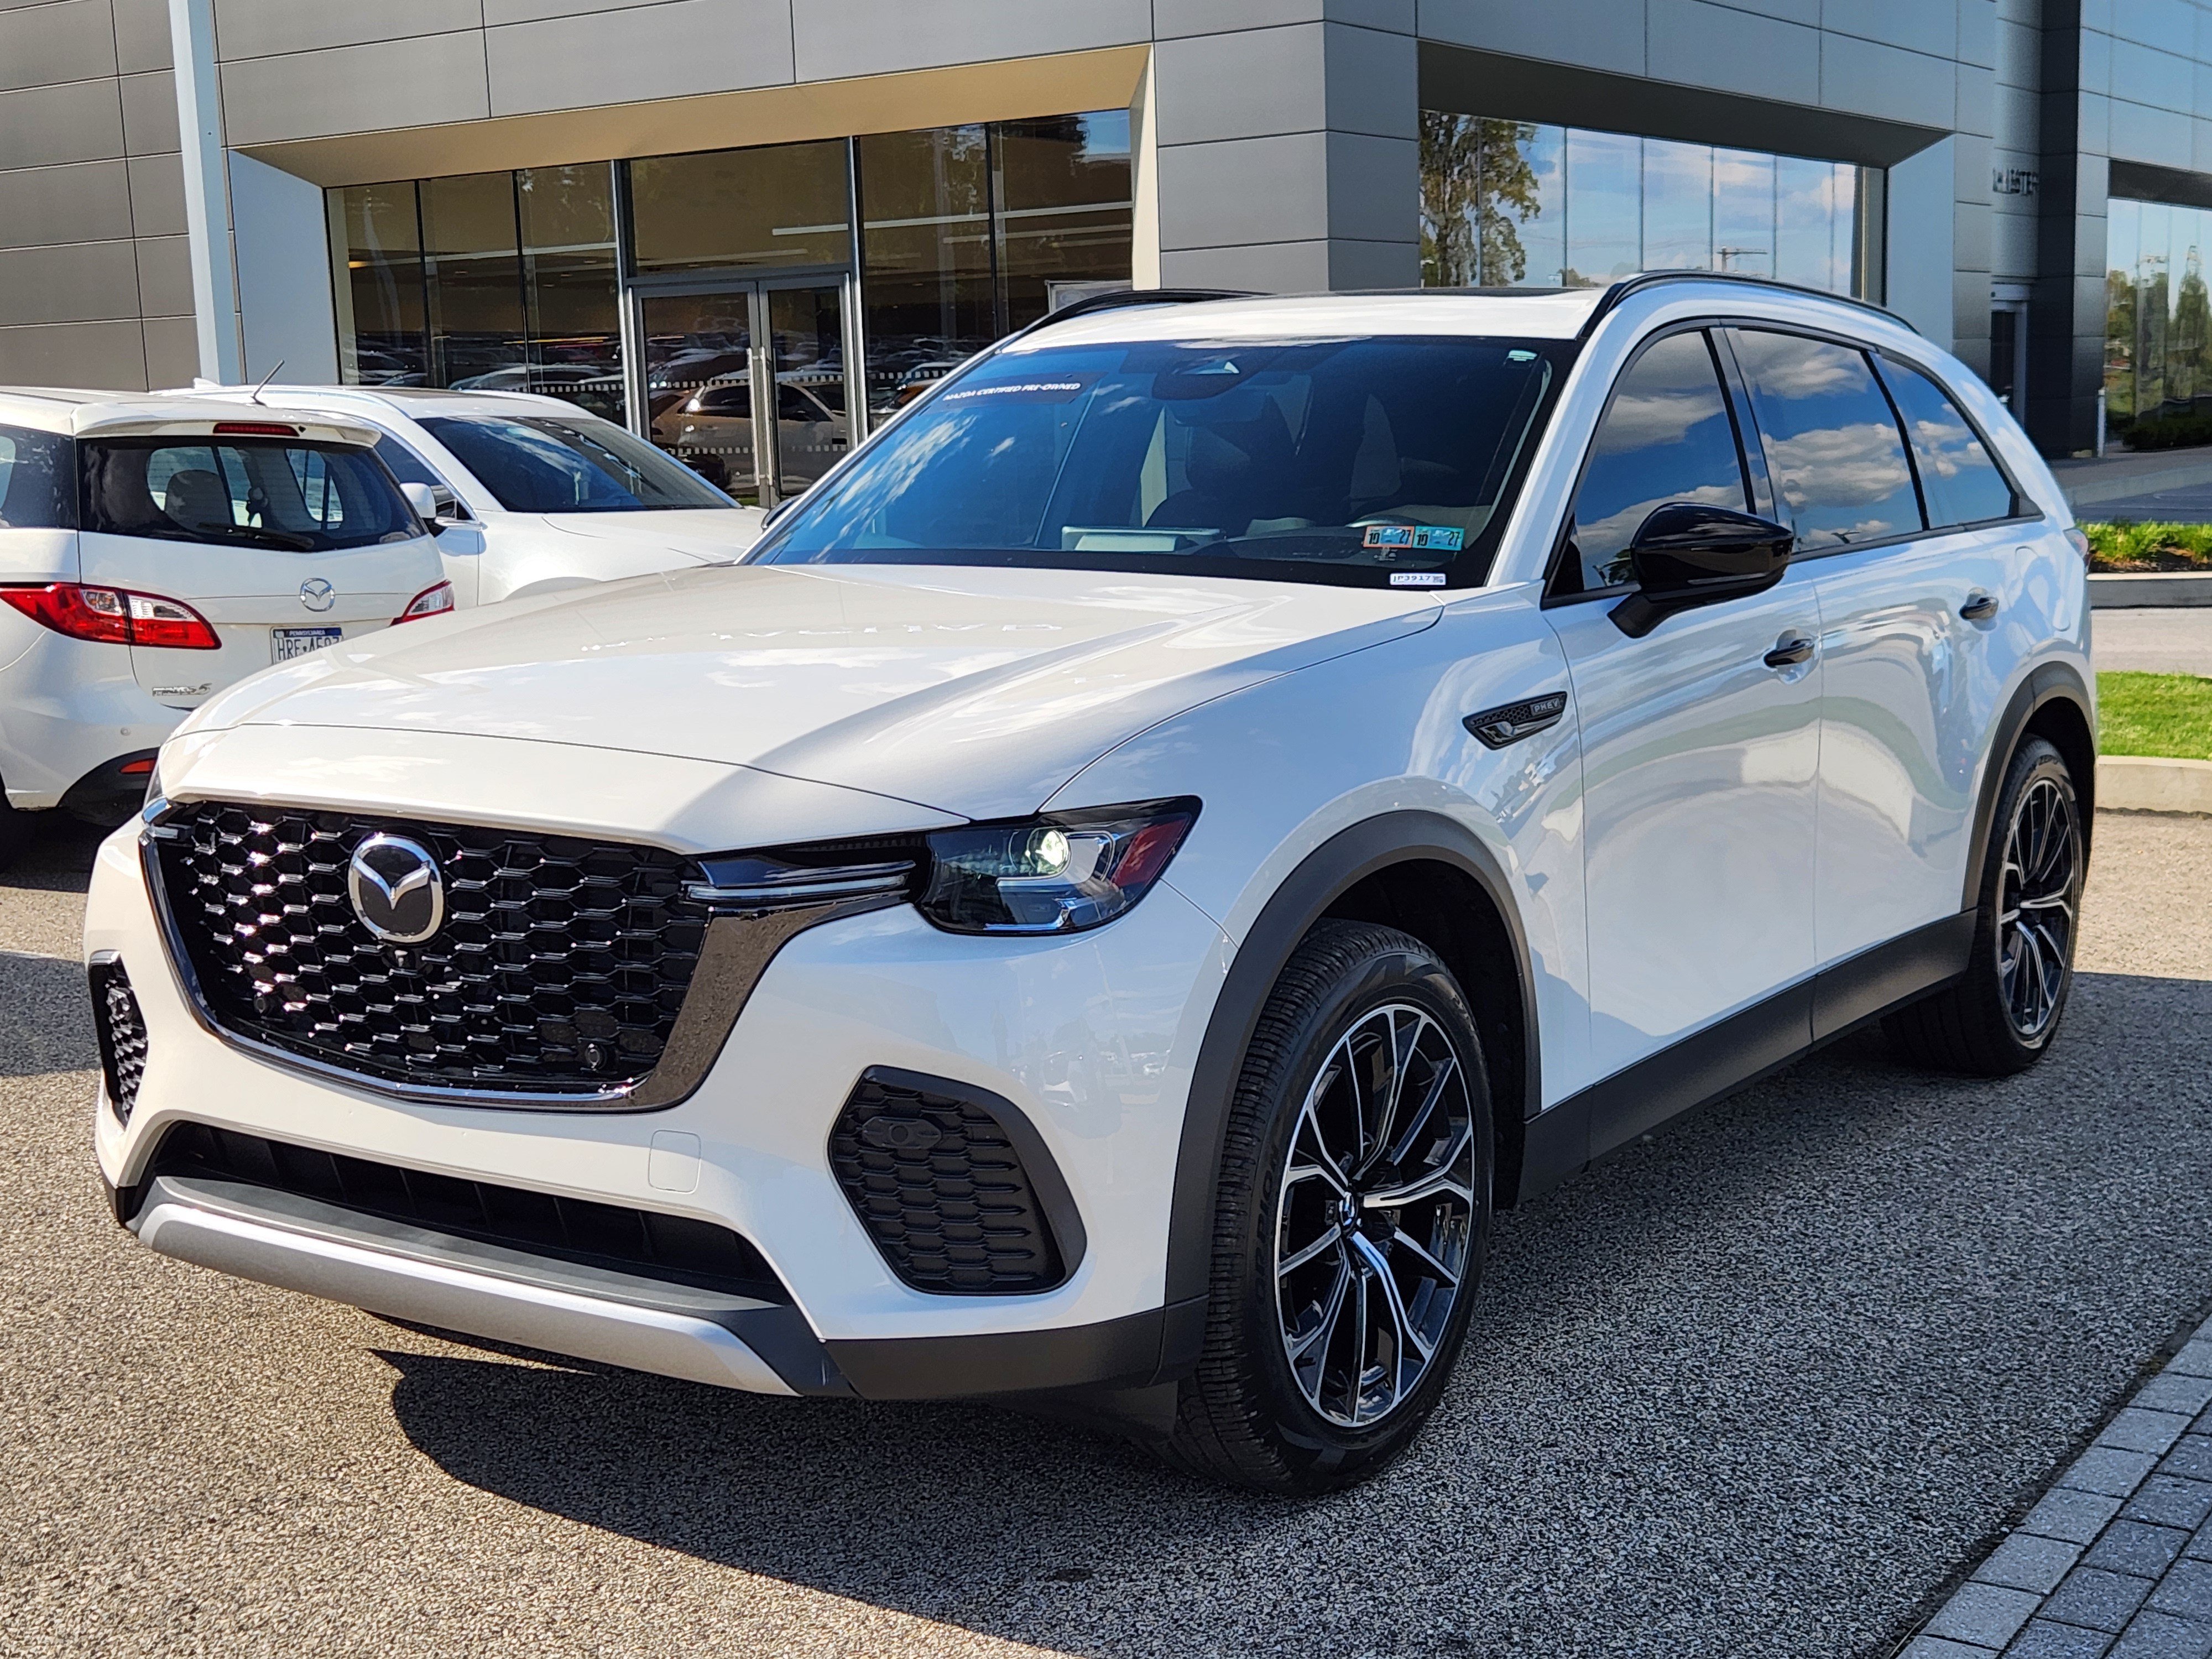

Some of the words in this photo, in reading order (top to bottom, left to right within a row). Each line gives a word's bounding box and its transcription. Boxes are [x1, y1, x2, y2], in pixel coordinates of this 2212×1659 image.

[977, 385, 1022, 395] CERTIFIED
[1022, 382, 1081, 392] PRE-OWNED
[1369, 533, 1380, 545] 10
[1399, 529, 1411, 545] 27
[1417, 534, 1428, 546] 10
[1448, 531, 1460, 547] 27
[1534, 700, 1558, 712] PHEV
